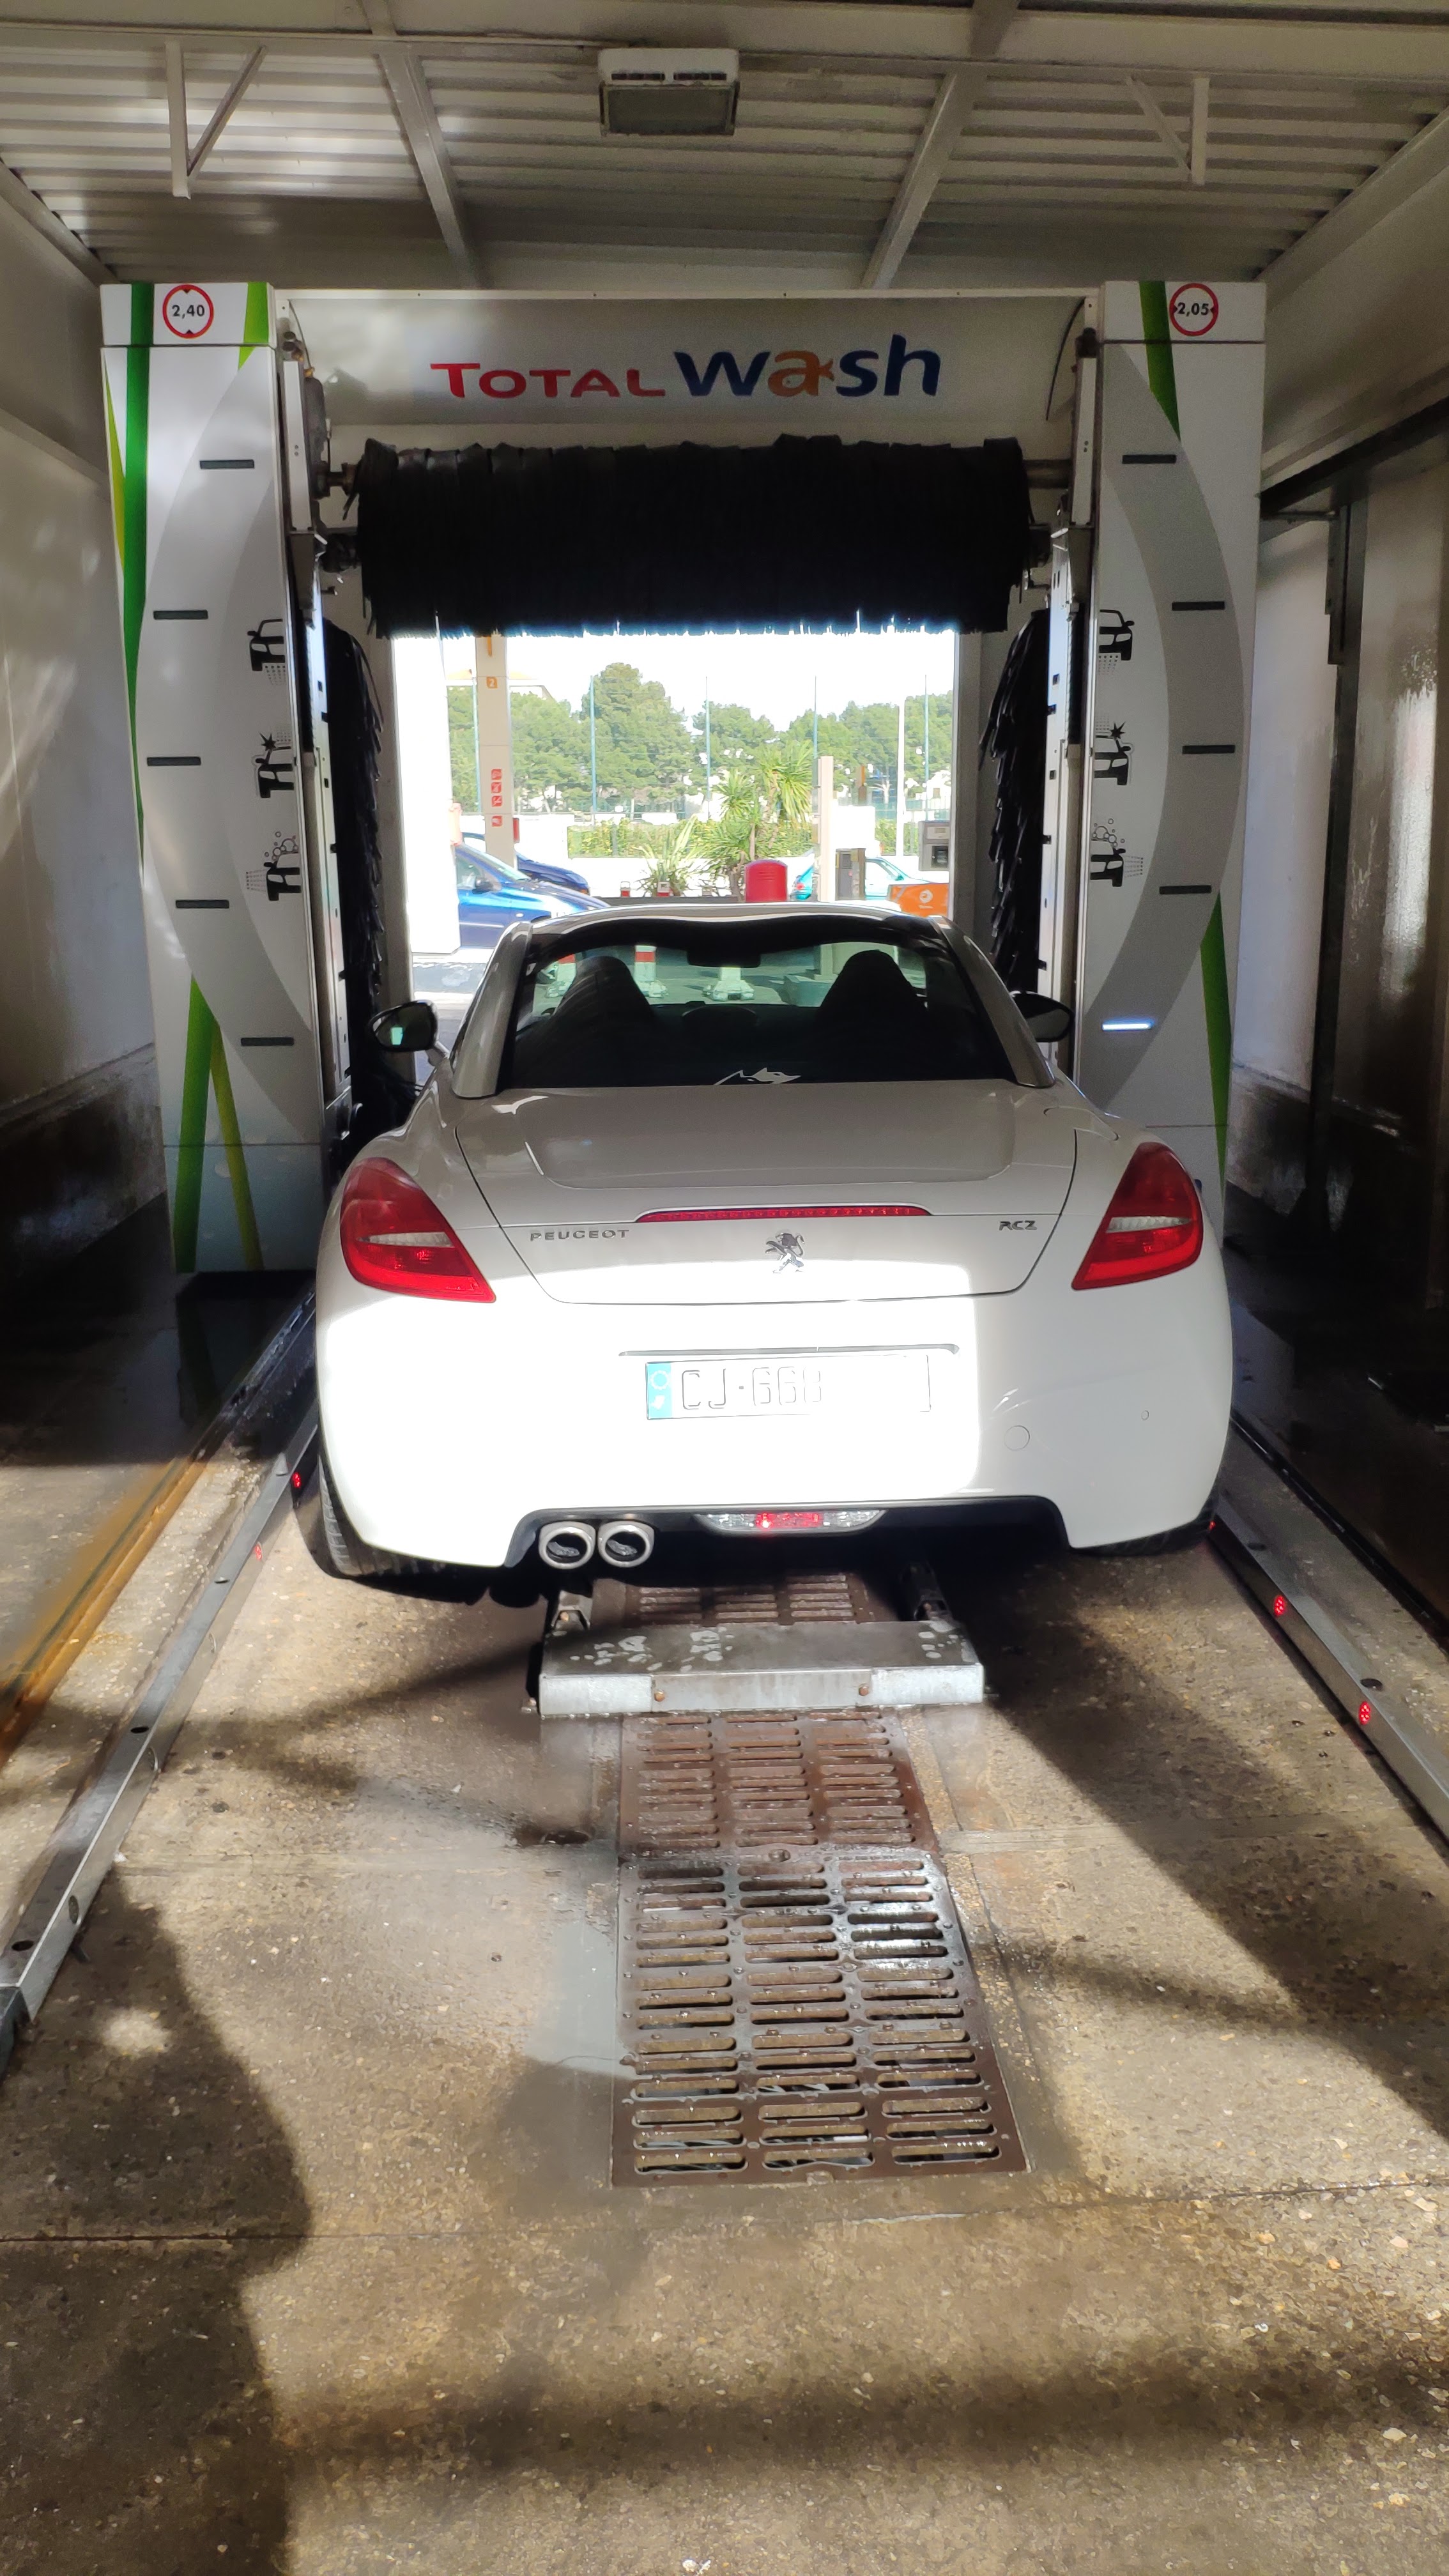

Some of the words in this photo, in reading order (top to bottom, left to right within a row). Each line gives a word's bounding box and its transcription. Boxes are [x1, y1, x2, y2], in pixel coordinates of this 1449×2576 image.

[172, 304, 205, 319] 2,40
[1177, 302, 1209, 317] 2,05
[673, 334, 941, 397] wash
[999, 1220, 1038, 1230] RCZ
[530, 1229, 629, 1241] PEUGEOT
